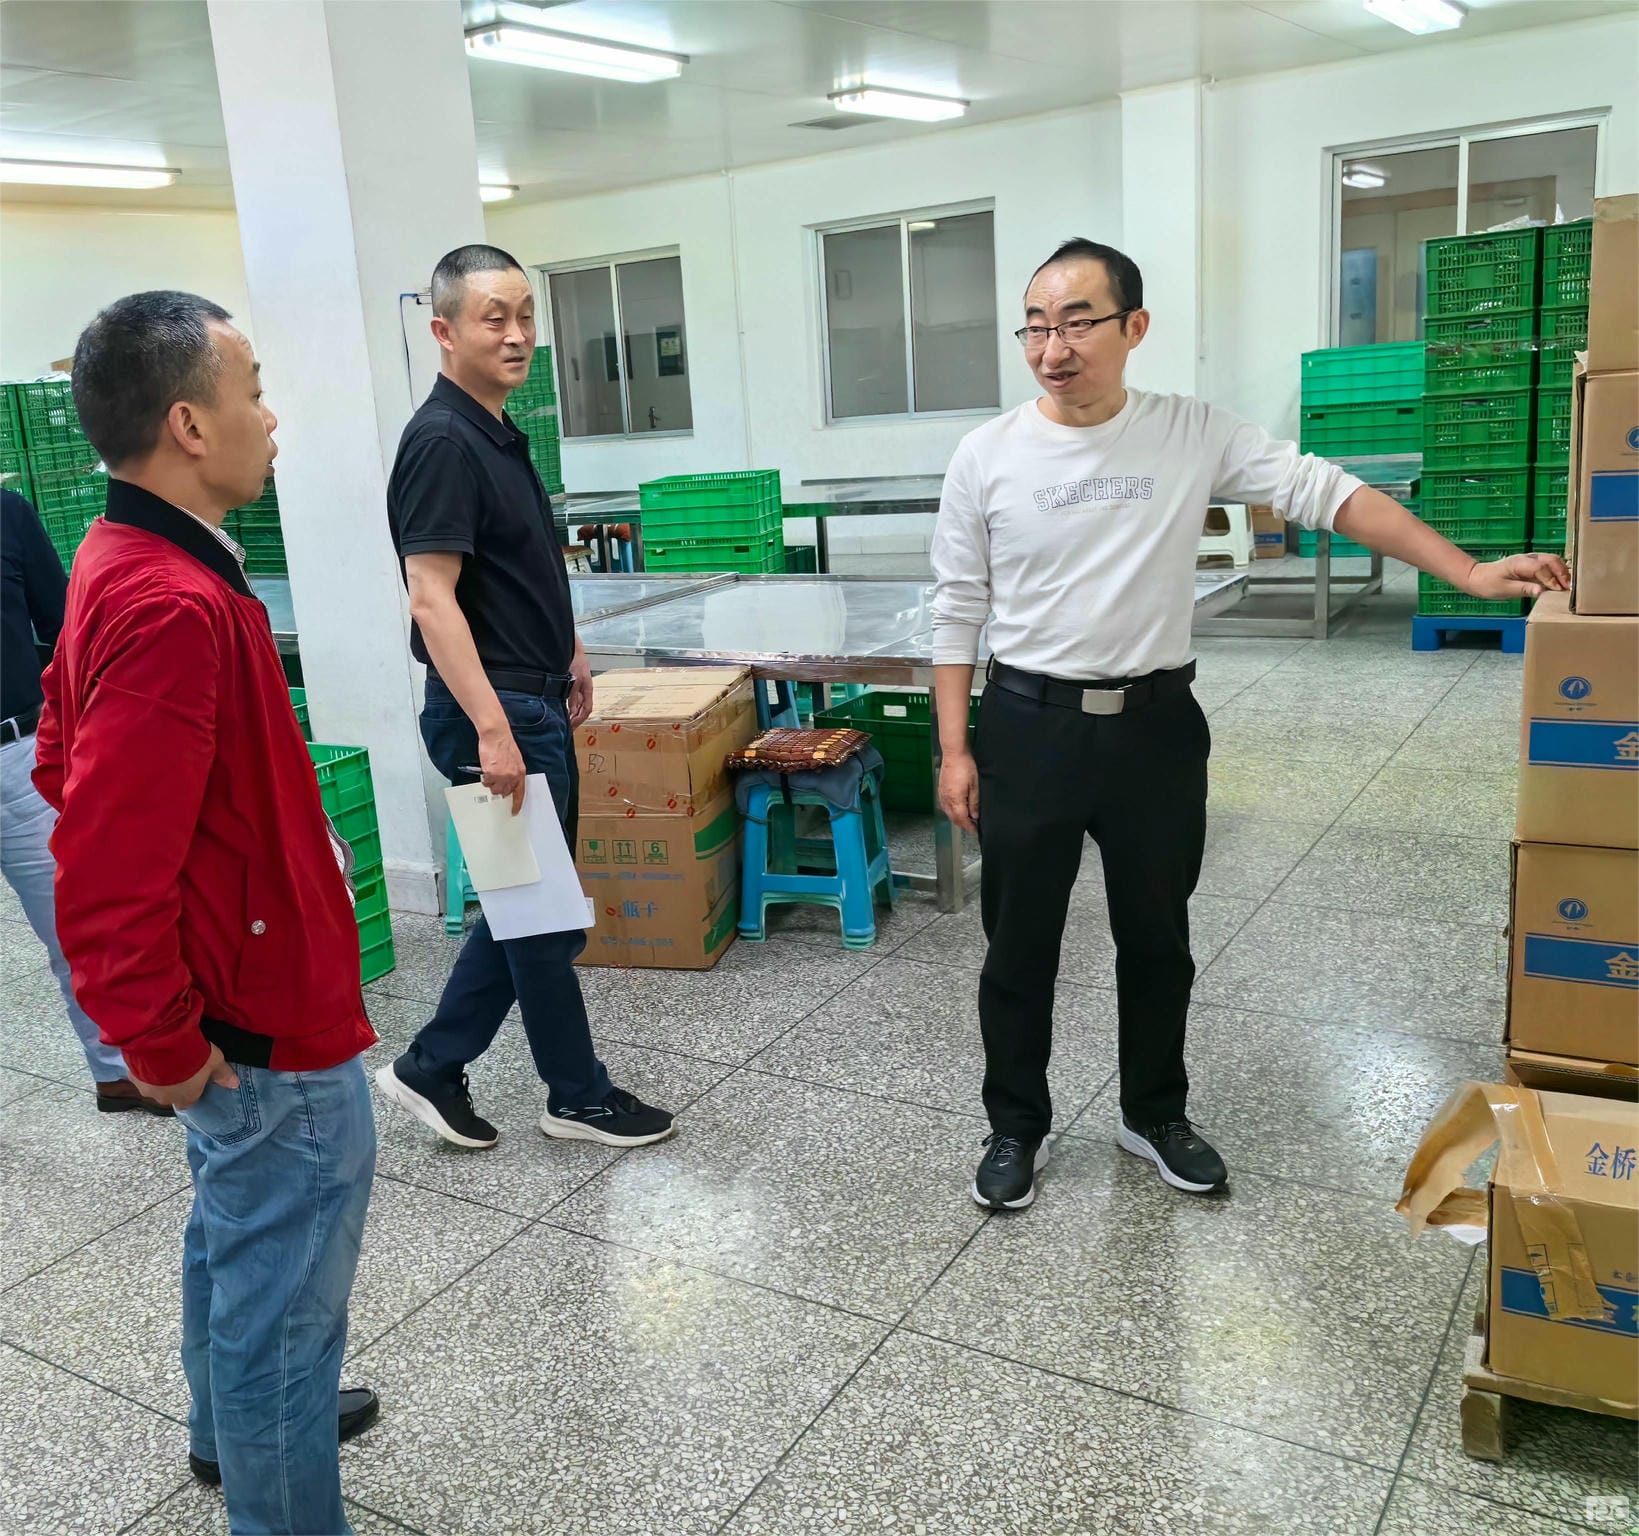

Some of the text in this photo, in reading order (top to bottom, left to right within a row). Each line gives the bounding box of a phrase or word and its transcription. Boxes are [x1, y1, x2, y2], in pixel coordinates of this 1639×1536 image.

[1033, 476, 1155, 512] SKECHERS
[1604, 951, 1639, 980] 金
[1584, 1142, 1638, 1181] 金桥
